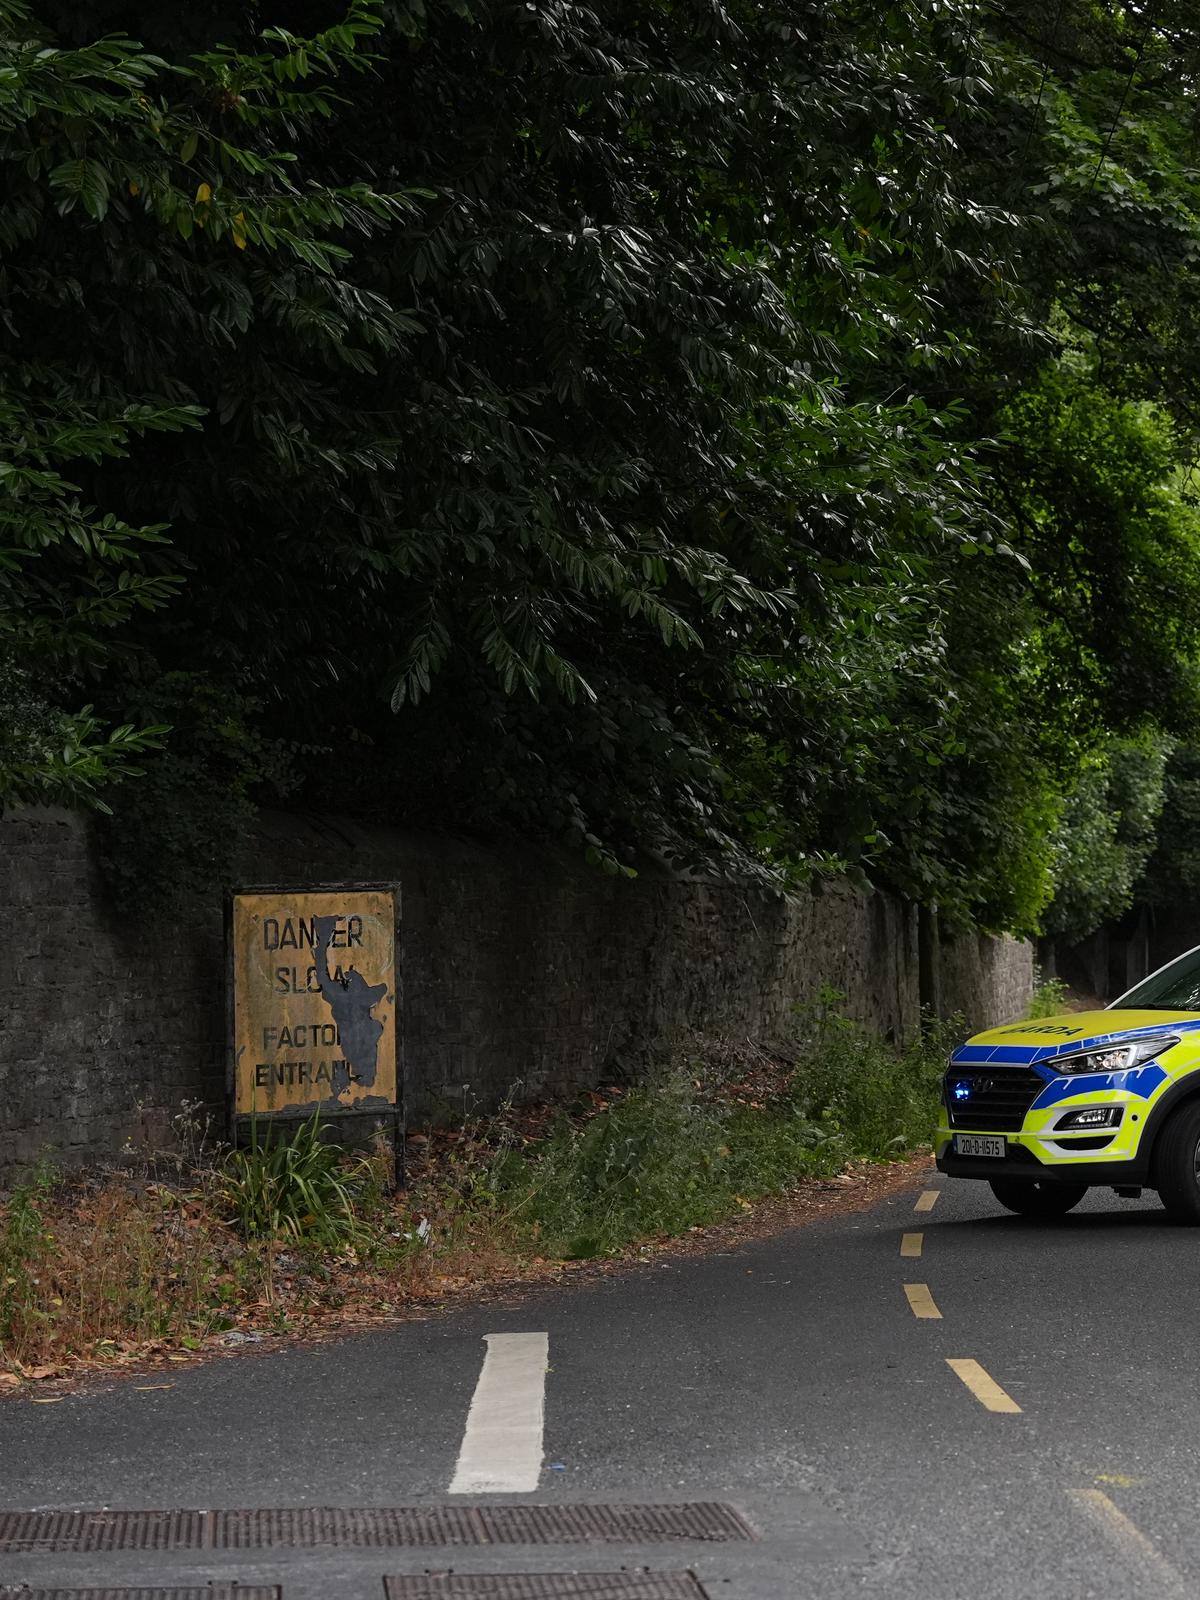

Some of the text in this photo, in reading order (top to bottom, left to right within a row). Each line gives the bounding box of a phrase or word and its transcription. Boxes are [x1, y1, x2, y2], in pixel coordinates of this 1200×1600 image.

[263, 915, 364, 950] DANER
[263, 1023, 342, 1050] FACTO
[255, 1059, 363, 1087] ENTRAN
